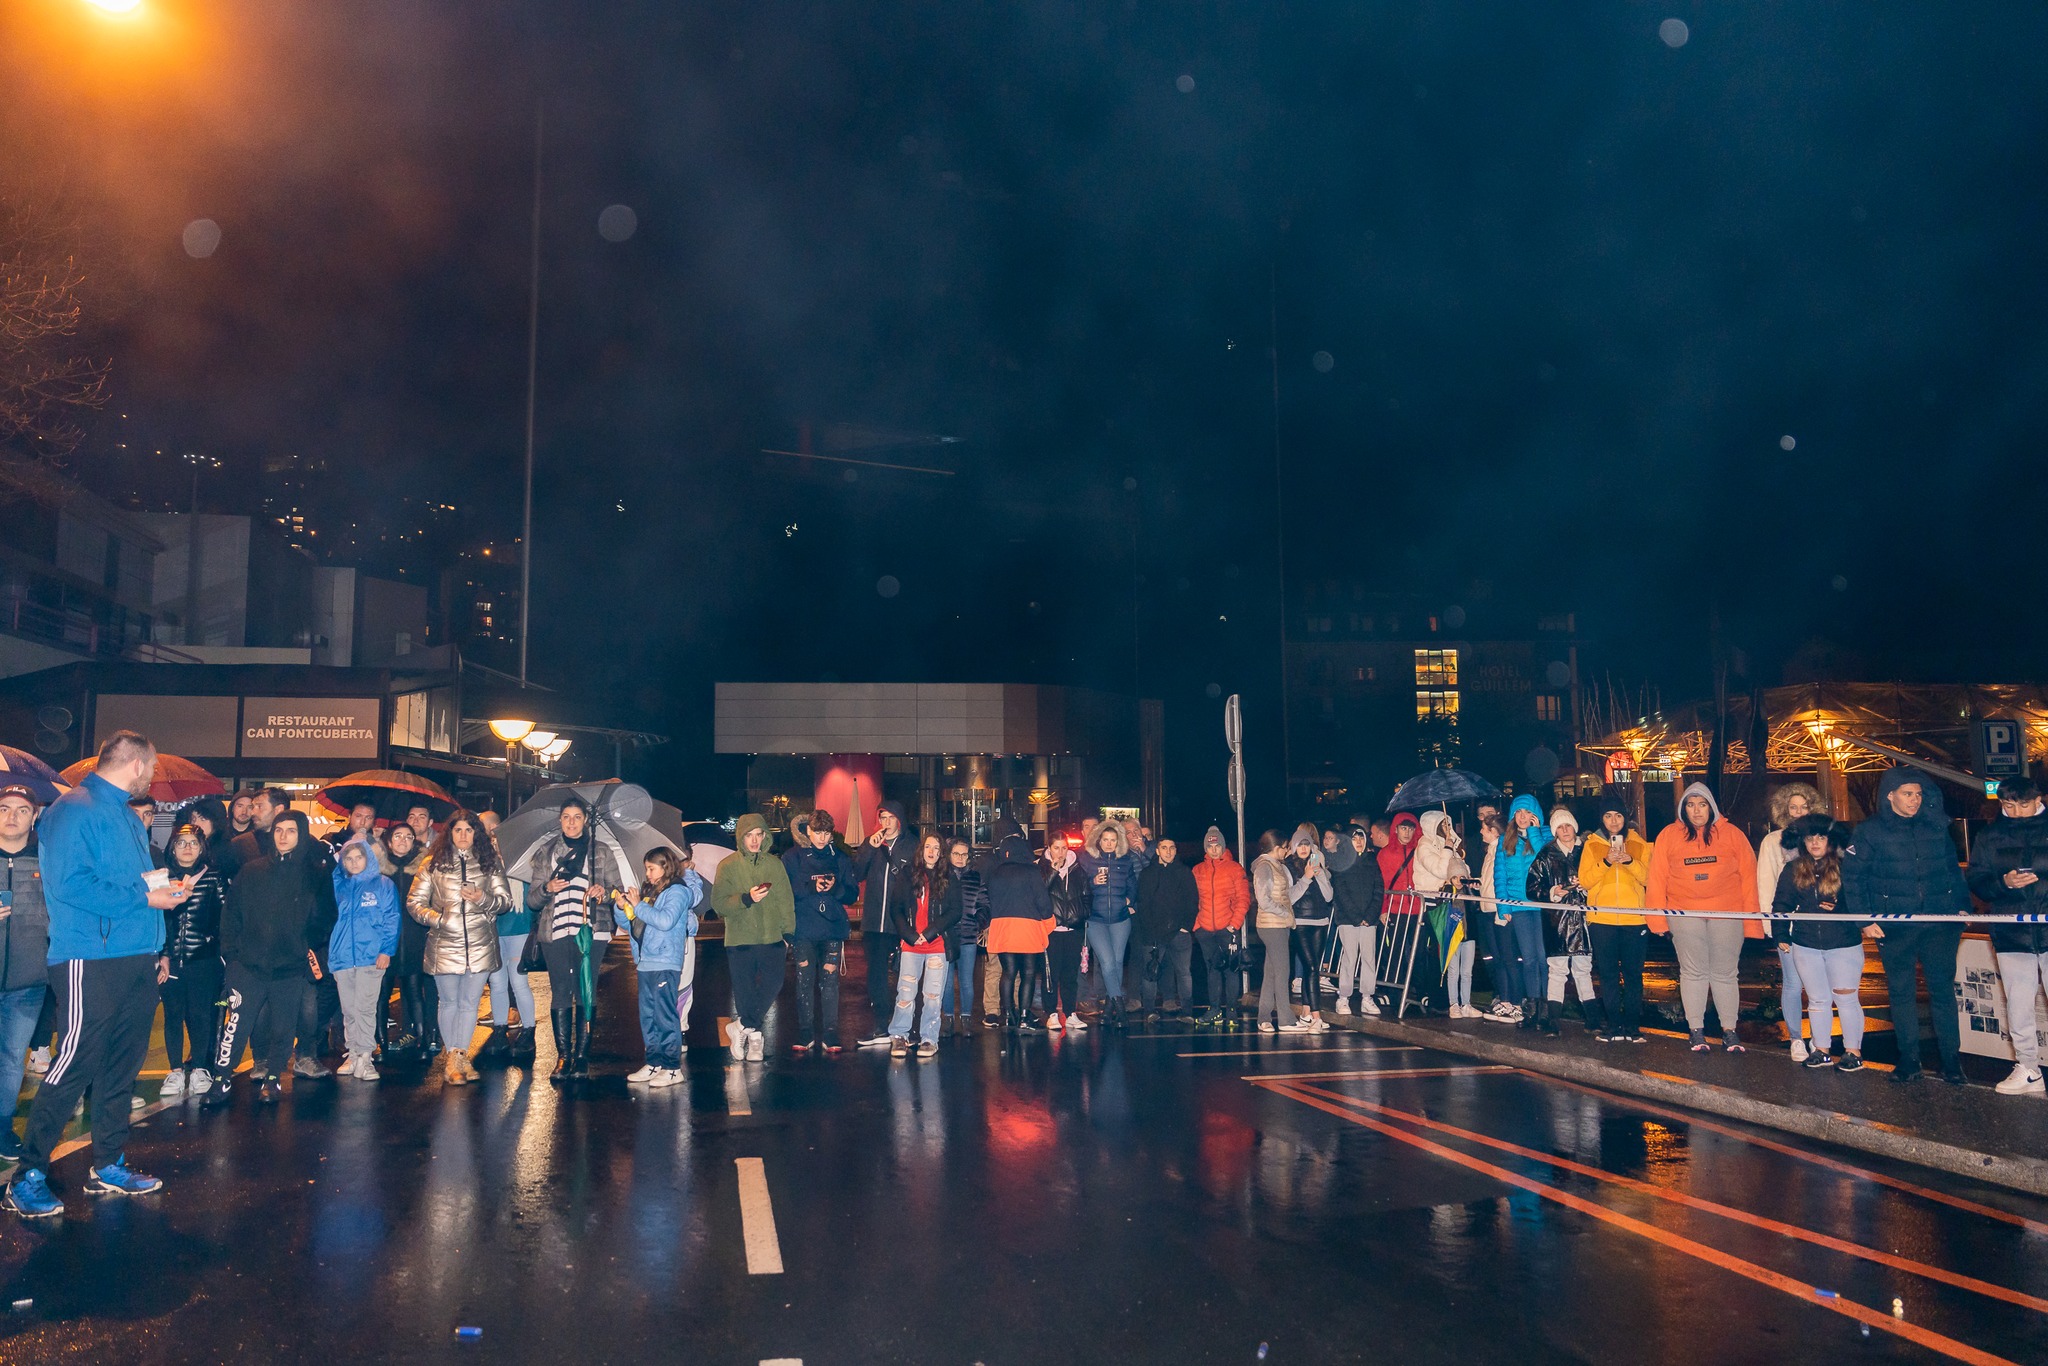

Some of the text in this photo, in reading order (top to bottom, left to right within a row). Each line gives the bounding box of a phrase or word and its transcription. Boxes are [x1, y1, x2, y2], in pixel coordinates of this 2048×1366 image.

[1479, 665, 1520, 677] HOTEL
[1470, 679, 1532, 692] GUILLEM
[267, 715, 354, 727] RESTAURANT
[246, 728, 374, 739] CAN FONTCUBERTA
[1989, 726, 2010, 753] P
[217, 1011, 240, 1067] adidas
